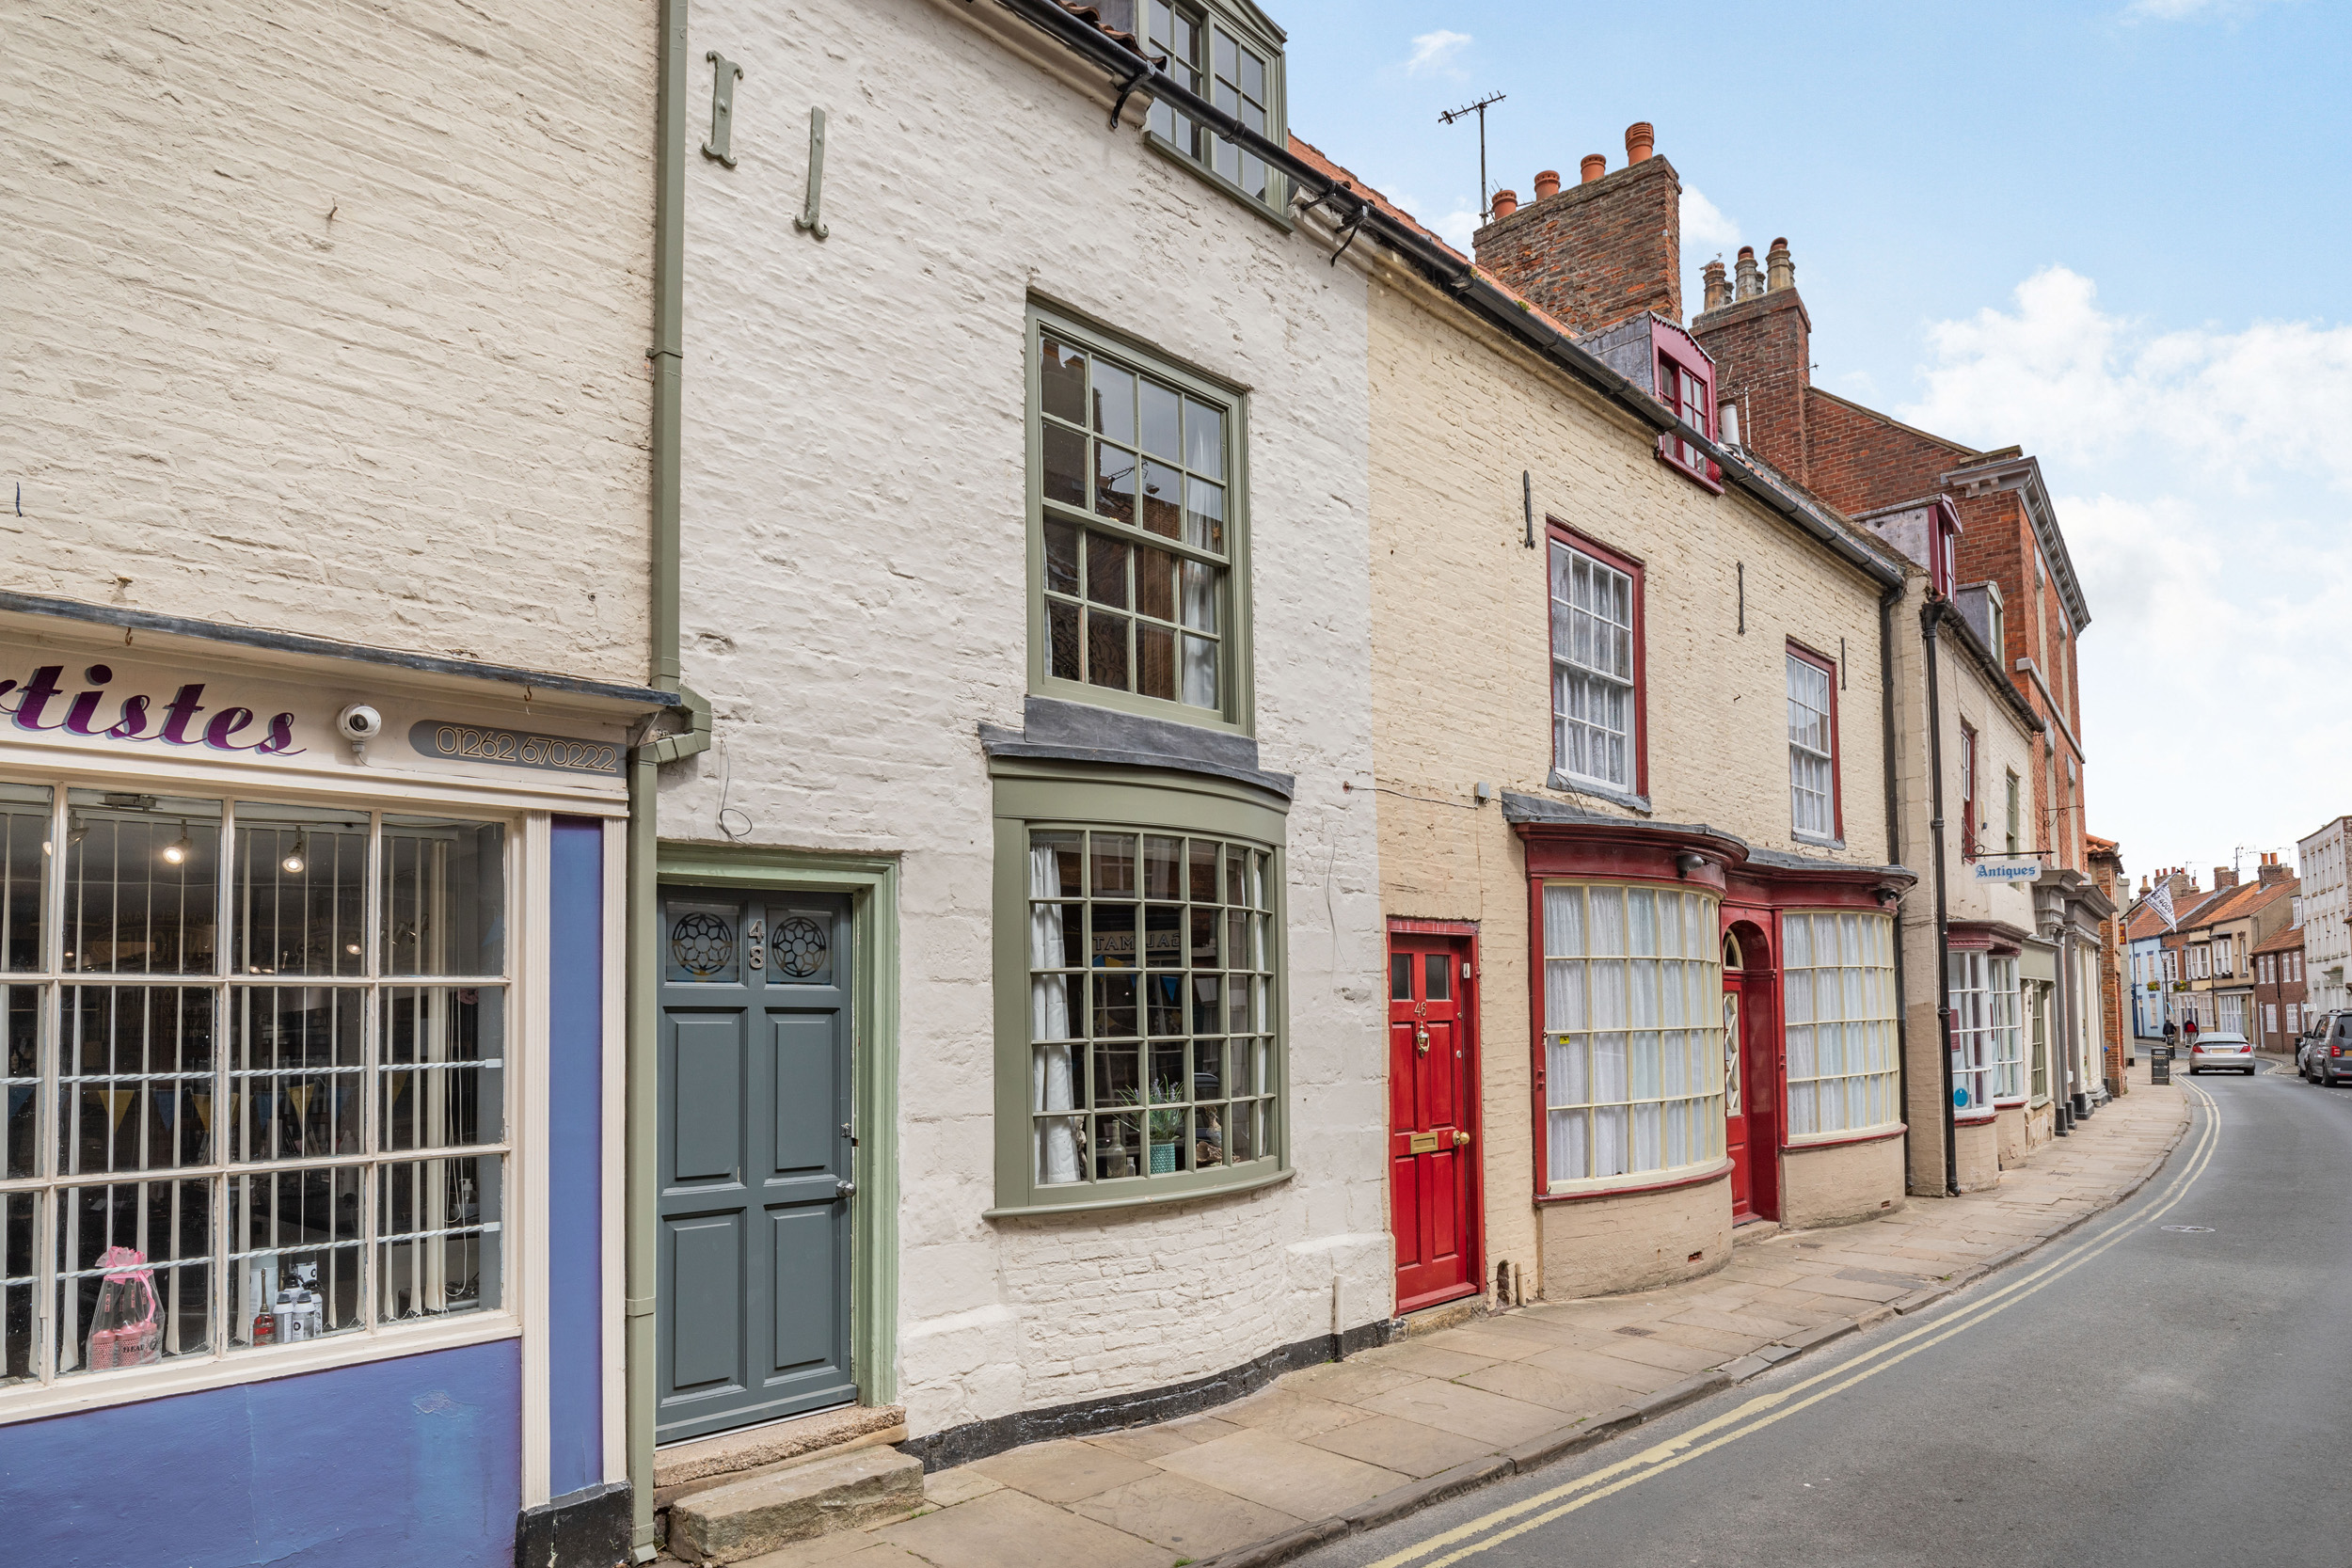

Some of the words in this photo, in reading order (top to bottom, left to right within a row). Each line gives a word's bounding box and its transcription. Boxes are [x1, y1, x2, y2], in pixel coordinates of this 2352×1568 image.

[436, 726, 516, 762] 01262
[520, 736, 617, 772] 670222
[1975, 864, 2036, 879] Antiques
[748, 919, 765, 970] 48
[1414, 1002, 1427, 1017] 46
